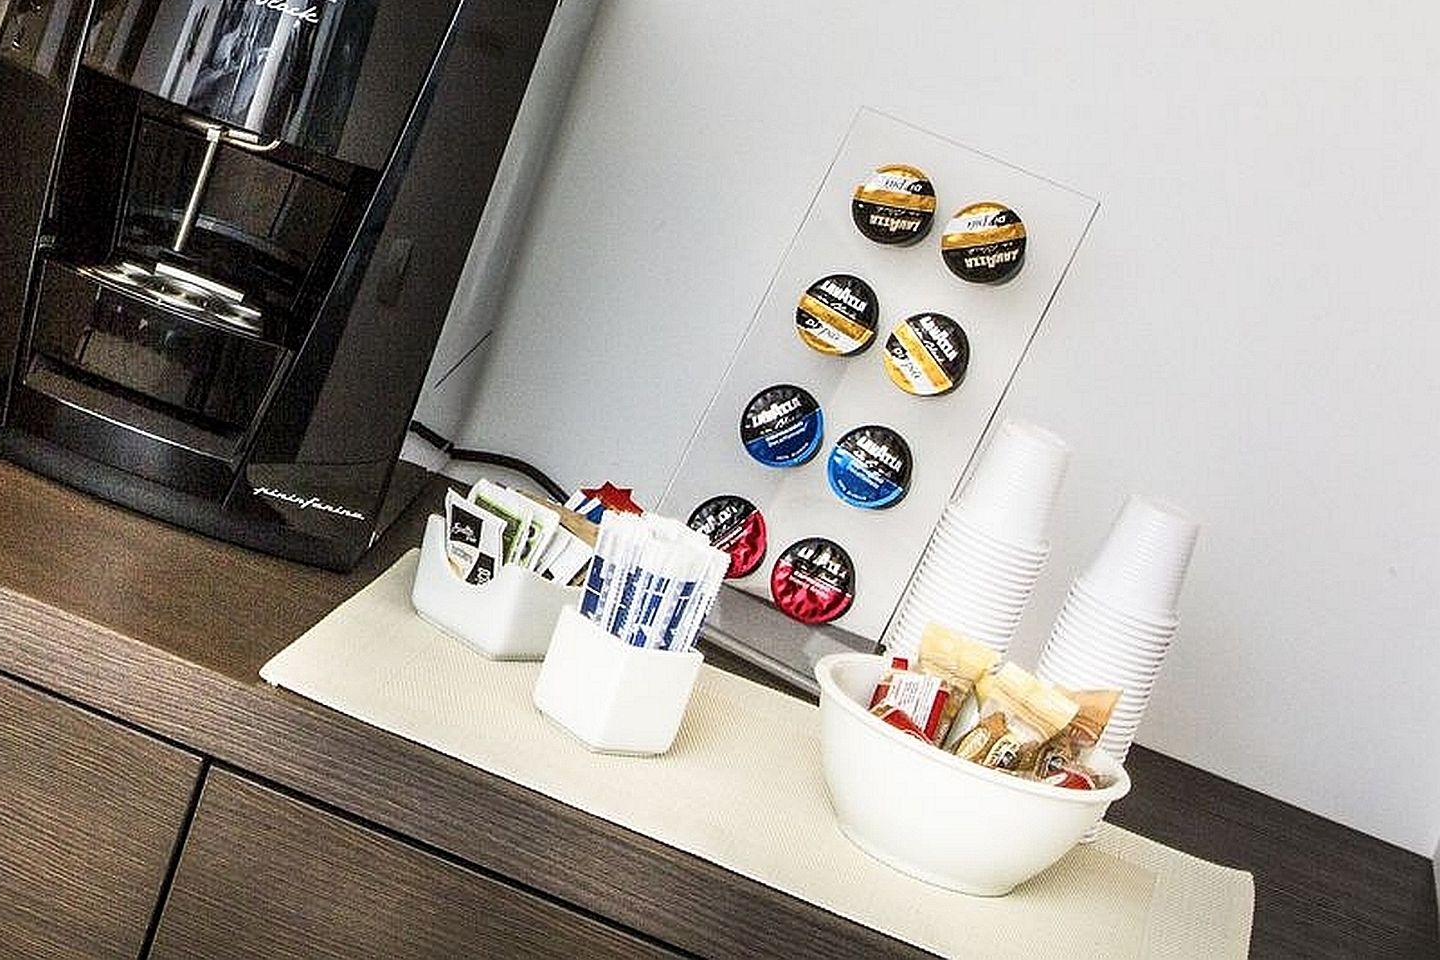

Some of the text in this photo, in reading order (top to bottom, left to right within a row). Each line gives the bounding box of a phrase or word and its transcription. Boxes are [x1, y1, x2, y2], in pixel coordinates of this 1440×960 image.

[869, 214, 921, 233] LAVAZZA
[964, 247, 1020, 269] LAVAZZA
[820, 280, 868, 314] LAVAZZA
[919, 315, 958, 361] LAVAZZA
[750, 397, 802, 428] LAVAZZA
[856, 436, 903, 473] LAVAZZA
